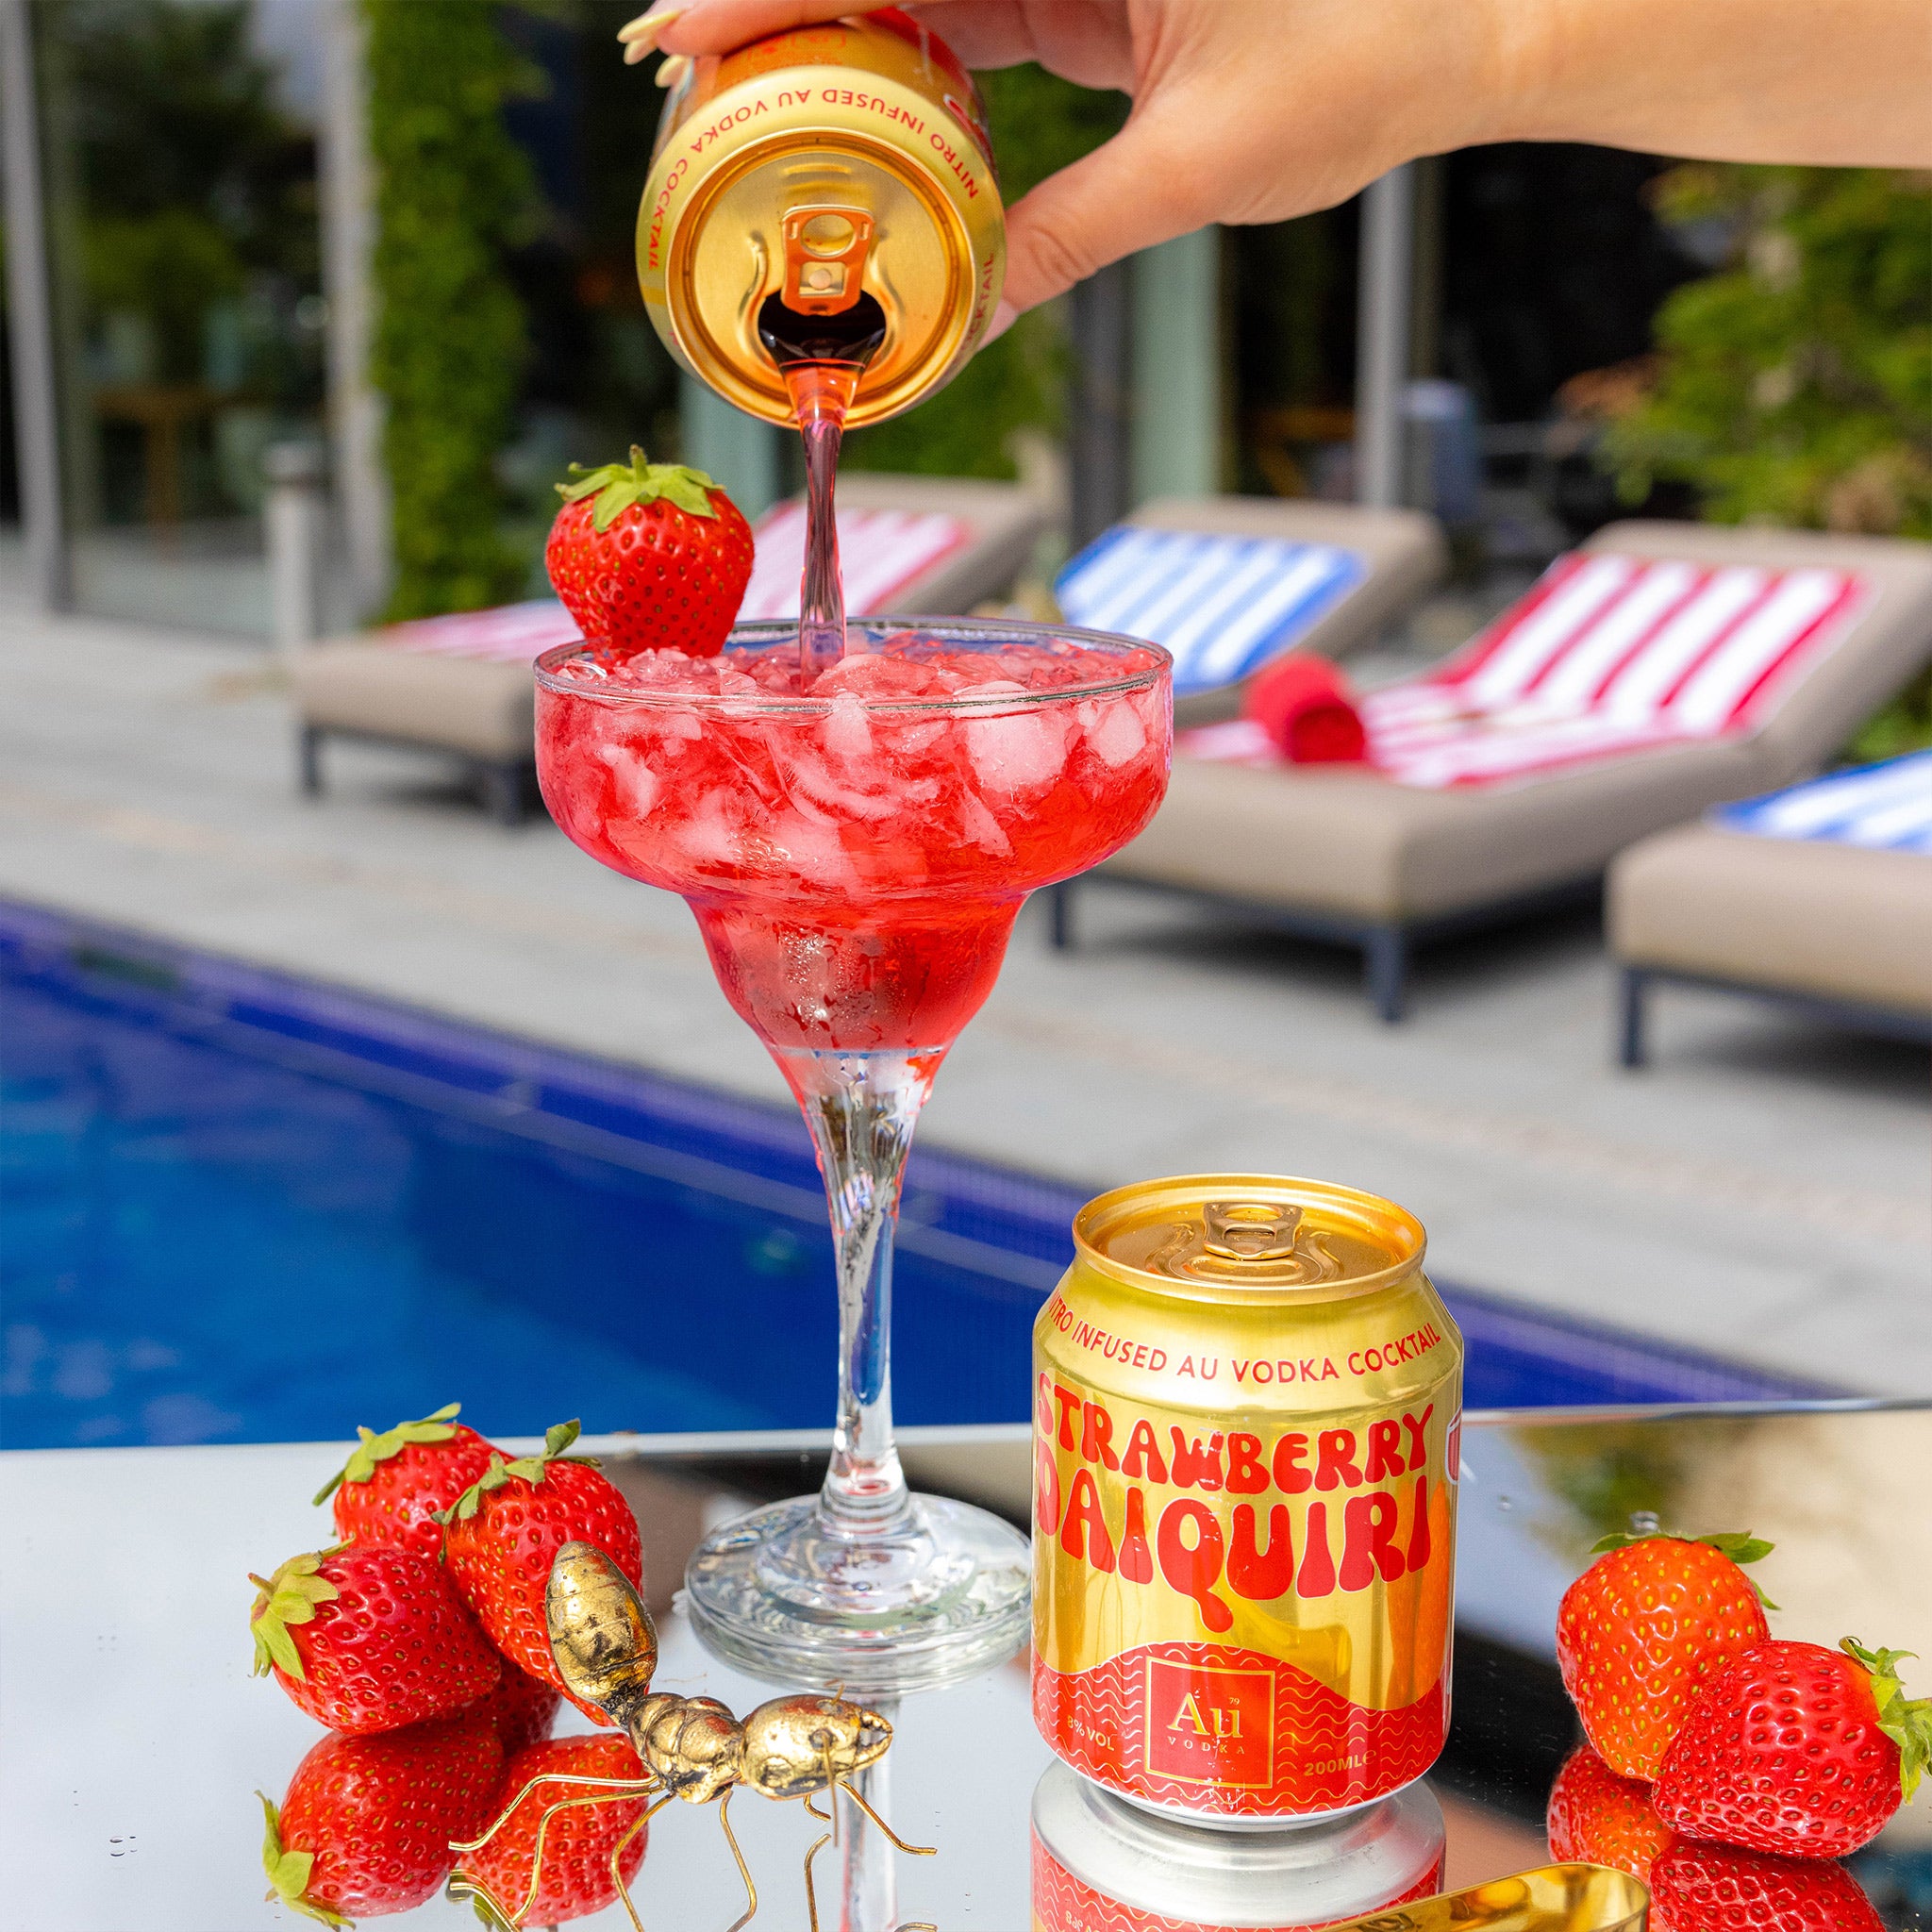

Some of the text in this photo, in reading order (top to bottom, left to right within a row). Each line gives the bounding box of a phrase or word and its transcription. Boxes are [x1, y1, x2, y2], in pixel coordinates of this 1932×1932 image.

[648, 89, 978, 270] NITRO INFUSED AU VODKA COCKTAIL
[1072, 1320, 1167, 1372] INFUSED
[1176, 1355, 1219, 1381] AU
[1231, 1357, 1341, 1384] VODKA
[1347, 1323, 1441, 1376] COCKTAIL
[1038, 1372, 1434, 1495] STRAWBERRY
[1037, 1437, 1432, 1634] DAIQUIRI
[1166, 1691, 1244, 1739] Au
[1167, 1735, 1245, 1755] VODKA
